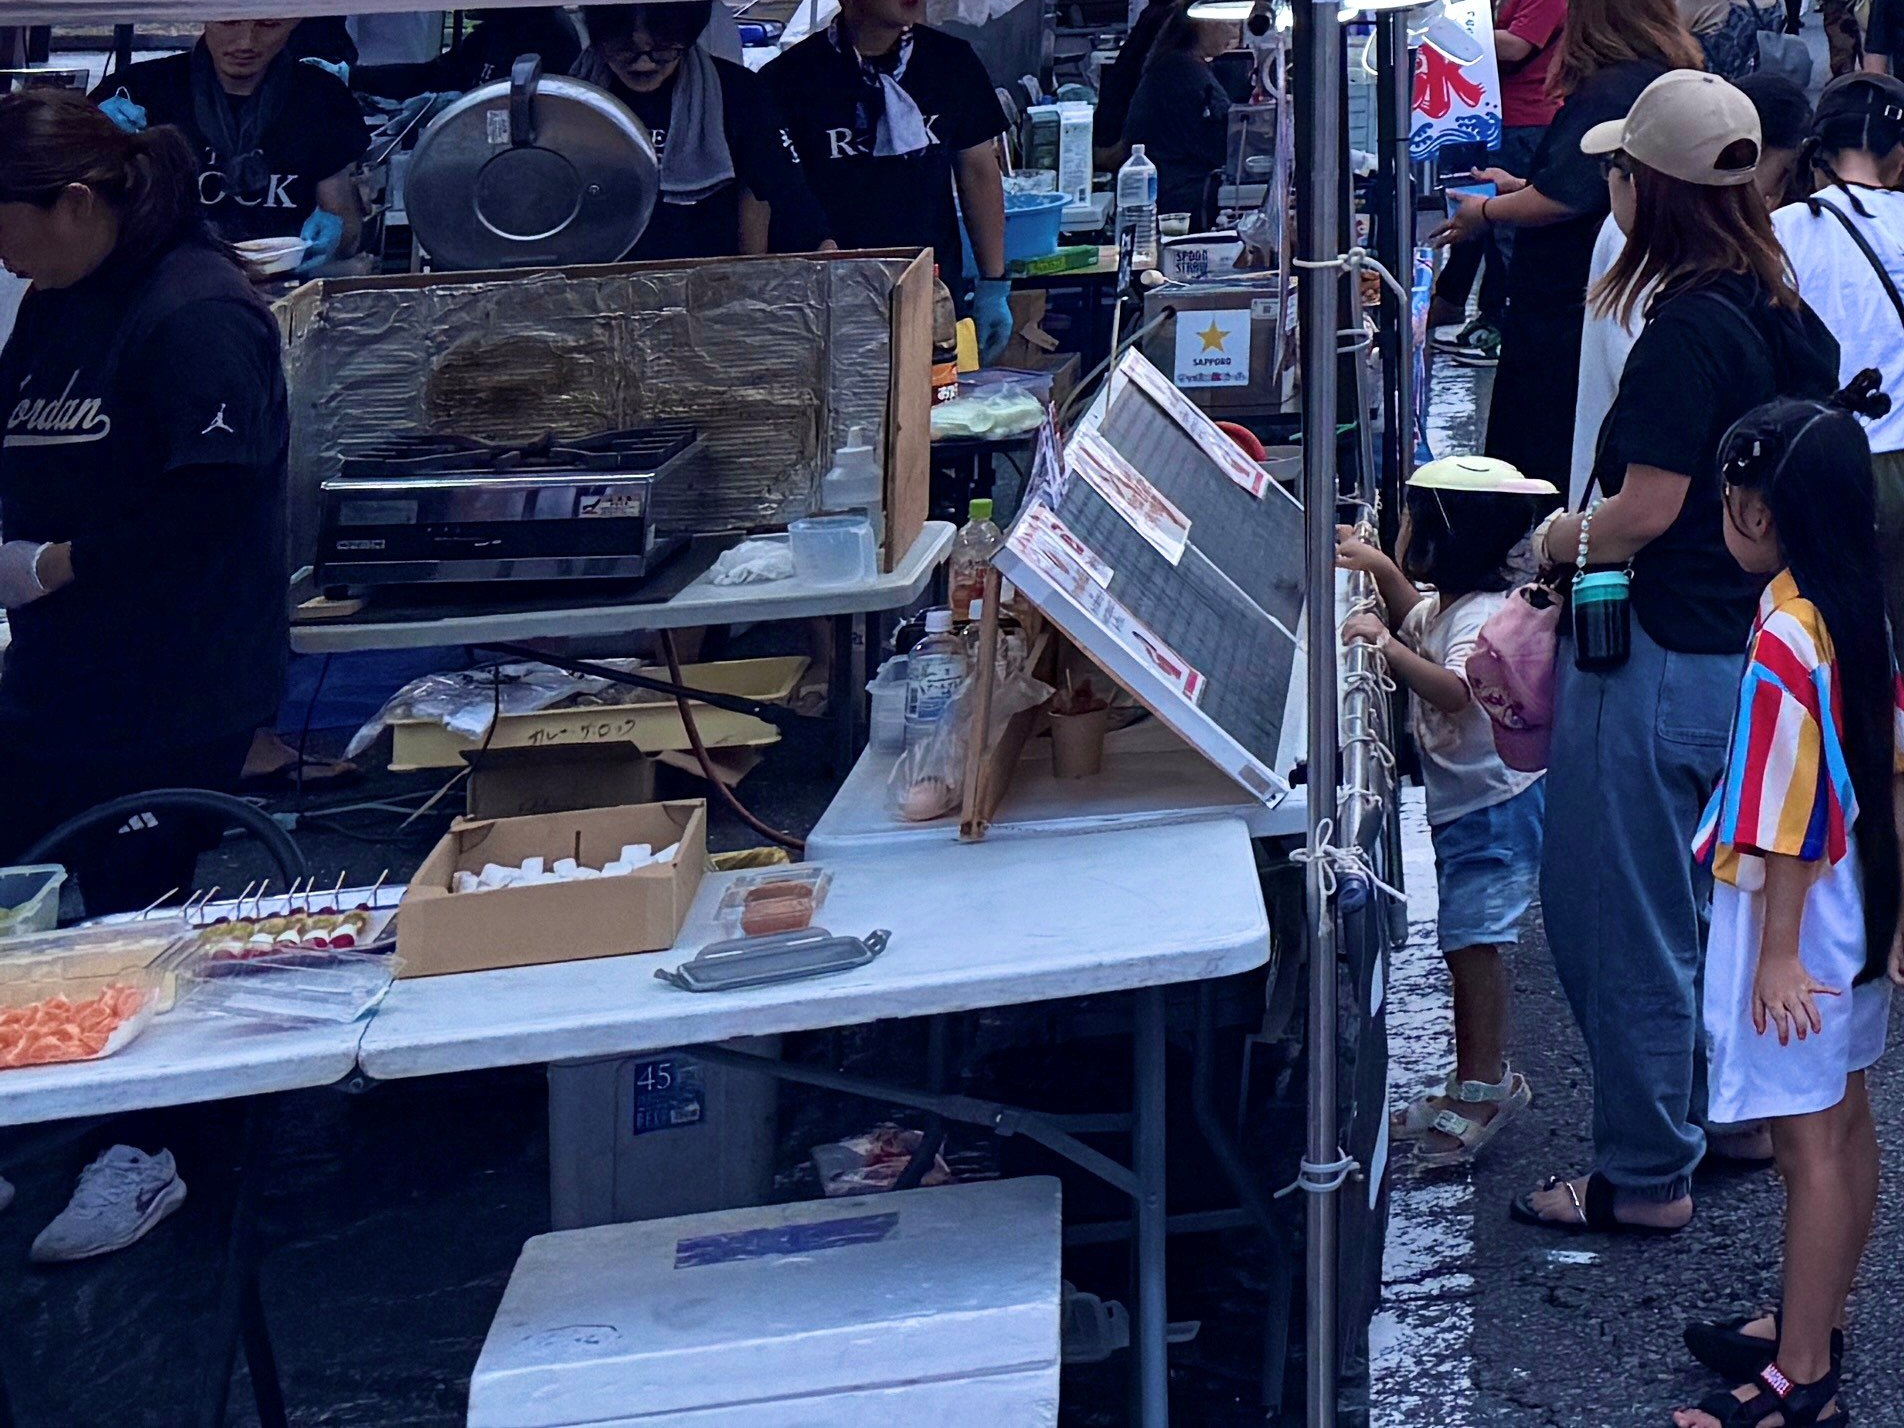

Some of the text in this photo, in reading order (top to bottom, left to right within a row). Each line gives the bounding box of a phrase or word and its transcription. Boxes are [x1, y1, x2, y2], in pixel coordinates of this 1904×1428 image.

[826, 114, 941, 159] RK
[198, 171, 299, 208] OK
[1192, 357, 1232, 367] SAPPORO
[6, 369, 108, 436] ordan
[637, 1063, 672, 1091] 45
